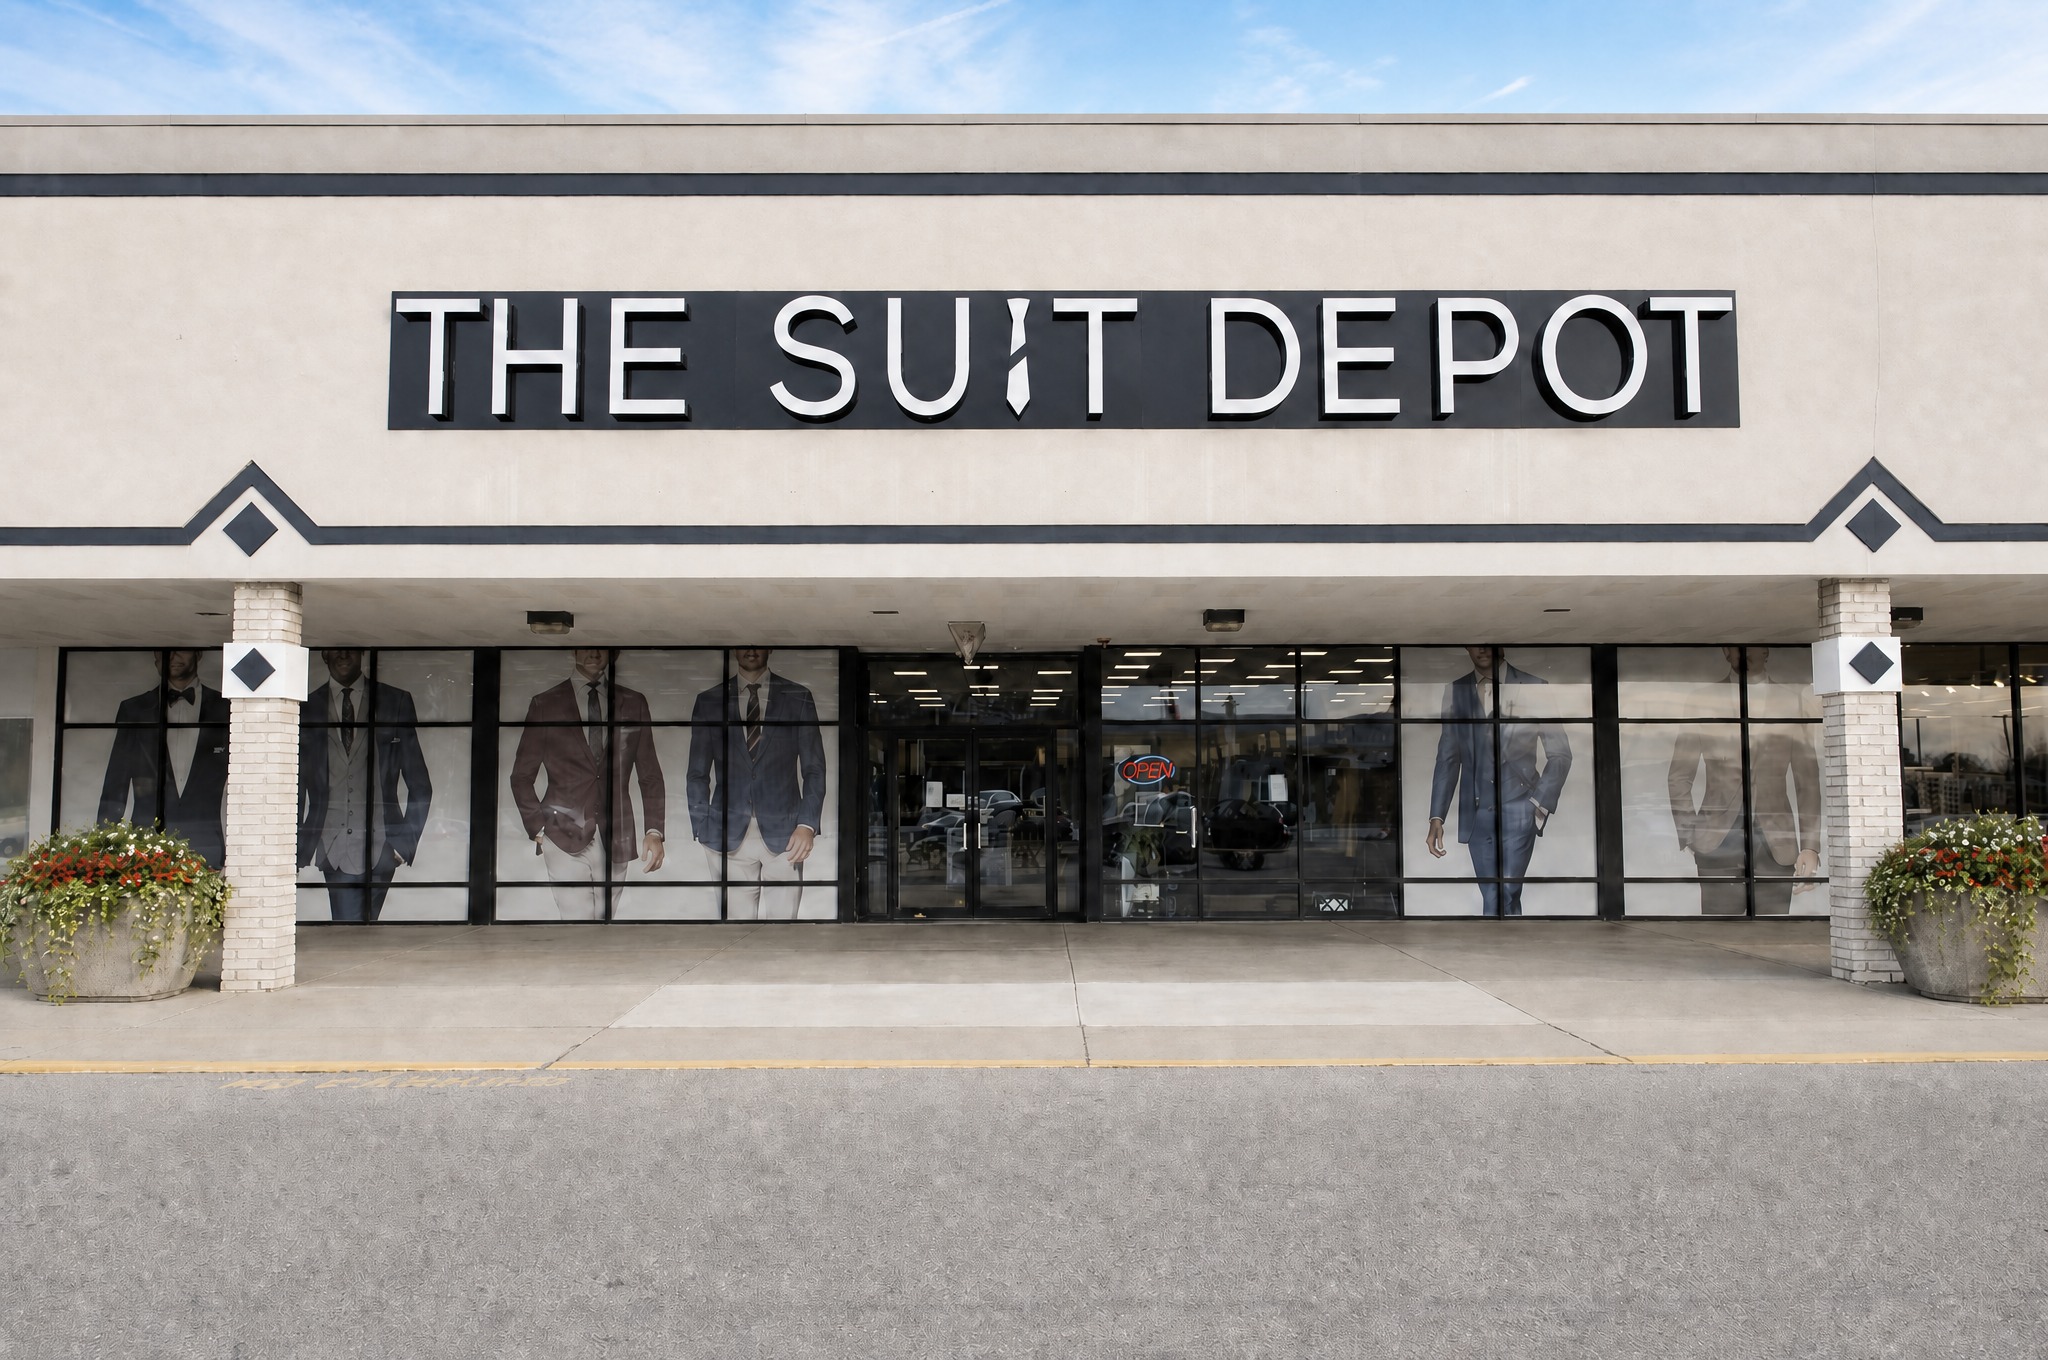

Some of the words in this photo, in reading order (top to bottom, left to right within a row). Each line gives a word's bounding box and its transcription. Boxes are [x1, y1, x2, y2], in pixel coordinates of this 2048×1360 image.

[395, 297, 690, 418] THE
[769, 294, 1138, 419] SUIT
[1205, 294, 1733, 419] DEPOT
[1122, 761, 1173, 779] OPEN
